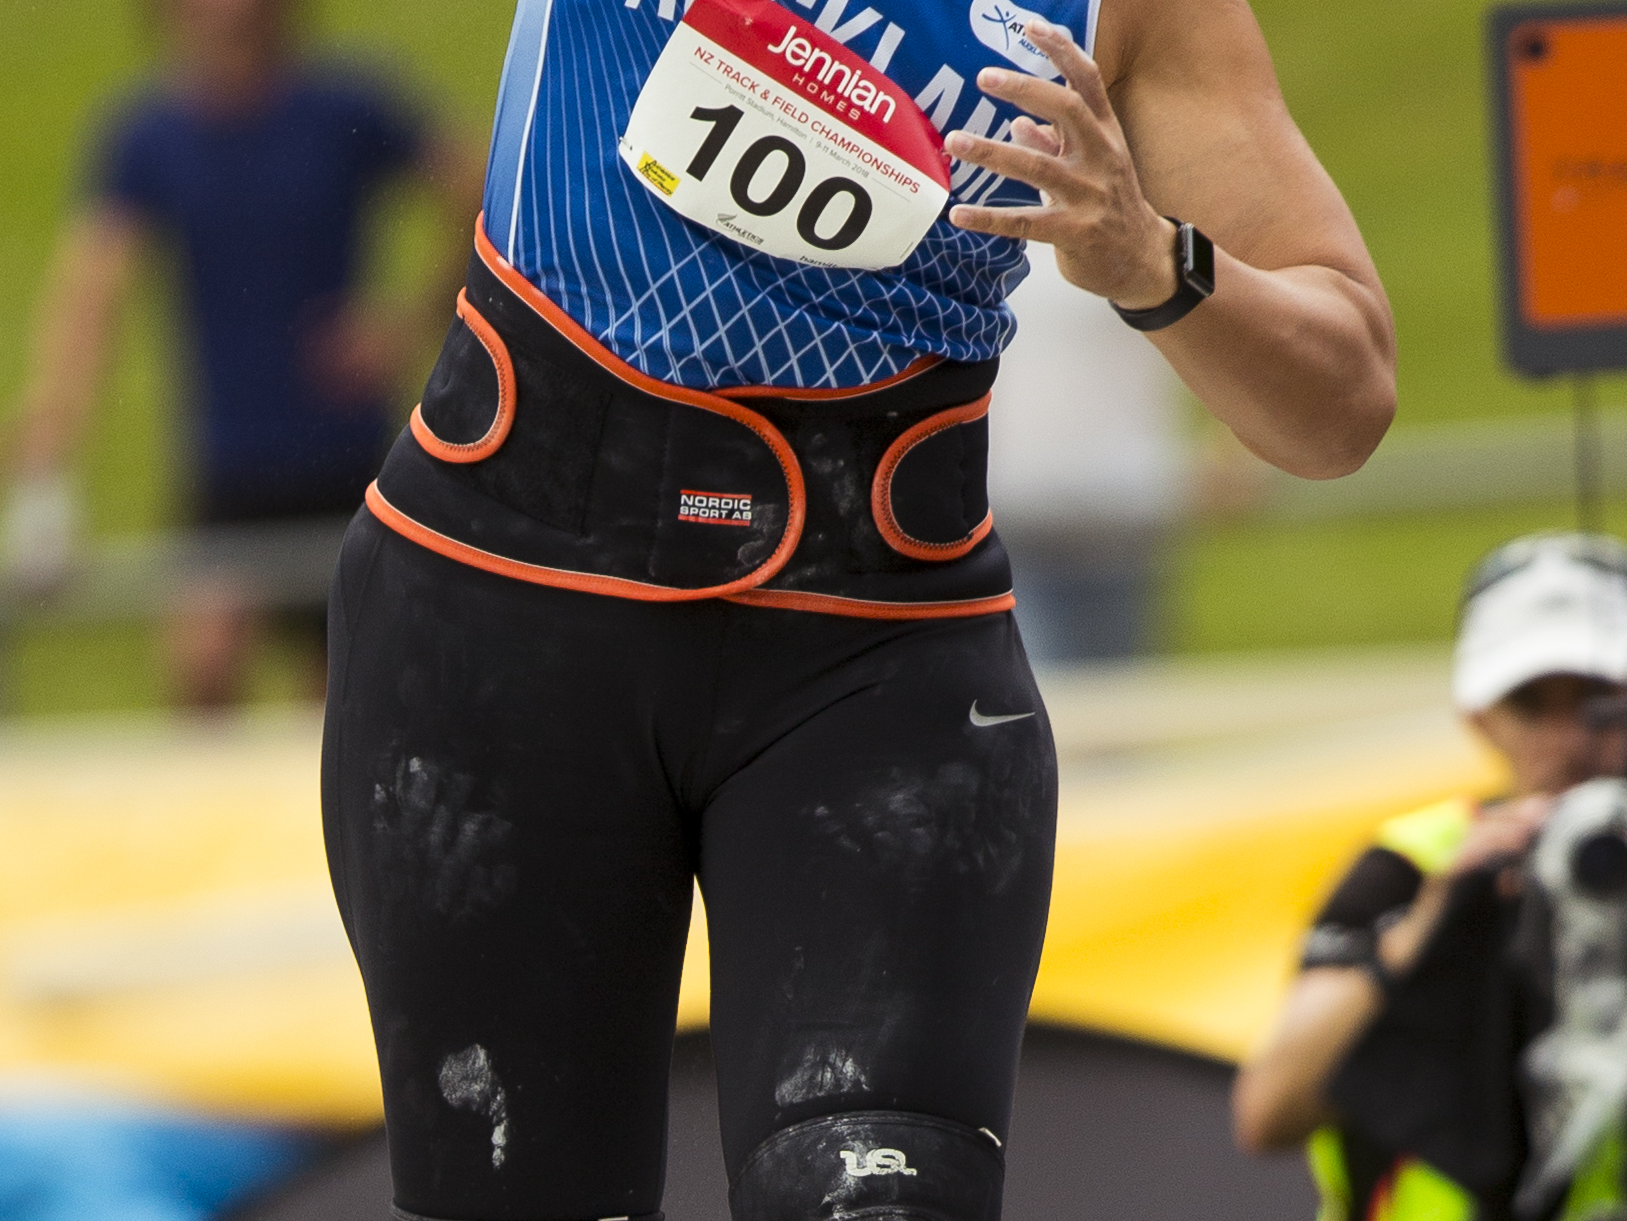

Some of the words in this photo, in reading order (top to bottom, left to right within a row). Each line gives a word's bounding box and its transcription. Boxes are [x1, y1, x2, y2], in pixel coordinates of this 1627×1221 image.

[767, 25, 897, 124] Jennian
[792, 72, 861, 120] HOMES
[694, 46, 715, 65] NZ
[716, 59, 760, 94] TRACK
[760, 88, 771, 101] &
[771, 95, 809, 124] FIELD
[811, 121, 920, 194] CHAMPIONSHIPS
[776, 117, 808, 140] Hamilton
[815, 142, 829, 154] 9-11
[829, 150, 851, 168] March
[851, 162, 870, 179] 2018
[685, 104, 873, 251] 100
[680, 494, 751, 510] NORDIC
[680, 505, 728, 519] SPORT
[732, 511, 752, 520] AB
